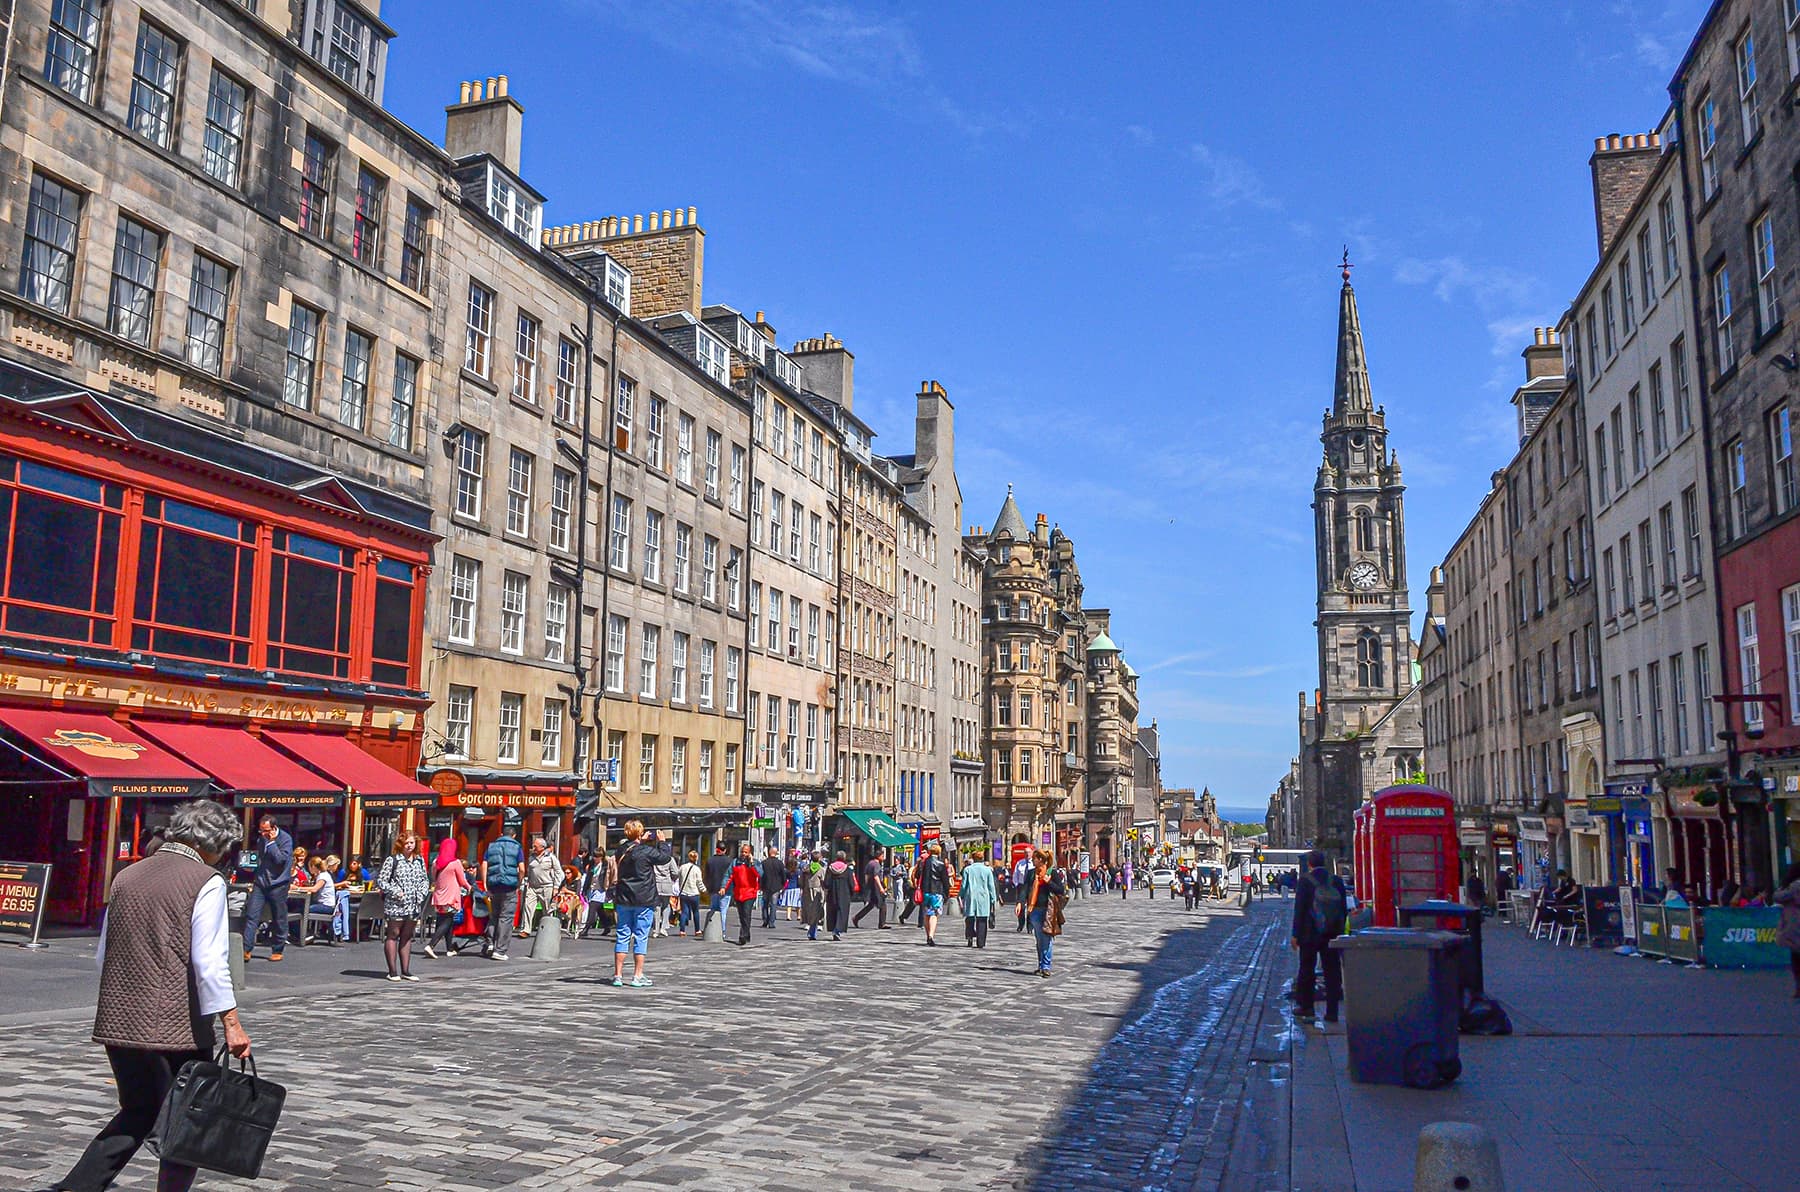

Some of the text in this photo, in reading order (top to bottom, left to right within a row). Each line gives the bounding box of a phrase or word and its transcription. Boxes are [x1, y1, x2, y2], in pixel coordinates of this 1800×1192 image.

[48, 675, 318, 721] THE FILLING STATION
[112, 785, 189, 793] FILLING STATION
[457, 793, 547, 805] Gordon's Trattoria
[1385, 807, 1444, 817] TELEPHONE
[5, 885, 38, 898] MENU
[1, 898, 36, 912] £6.95
